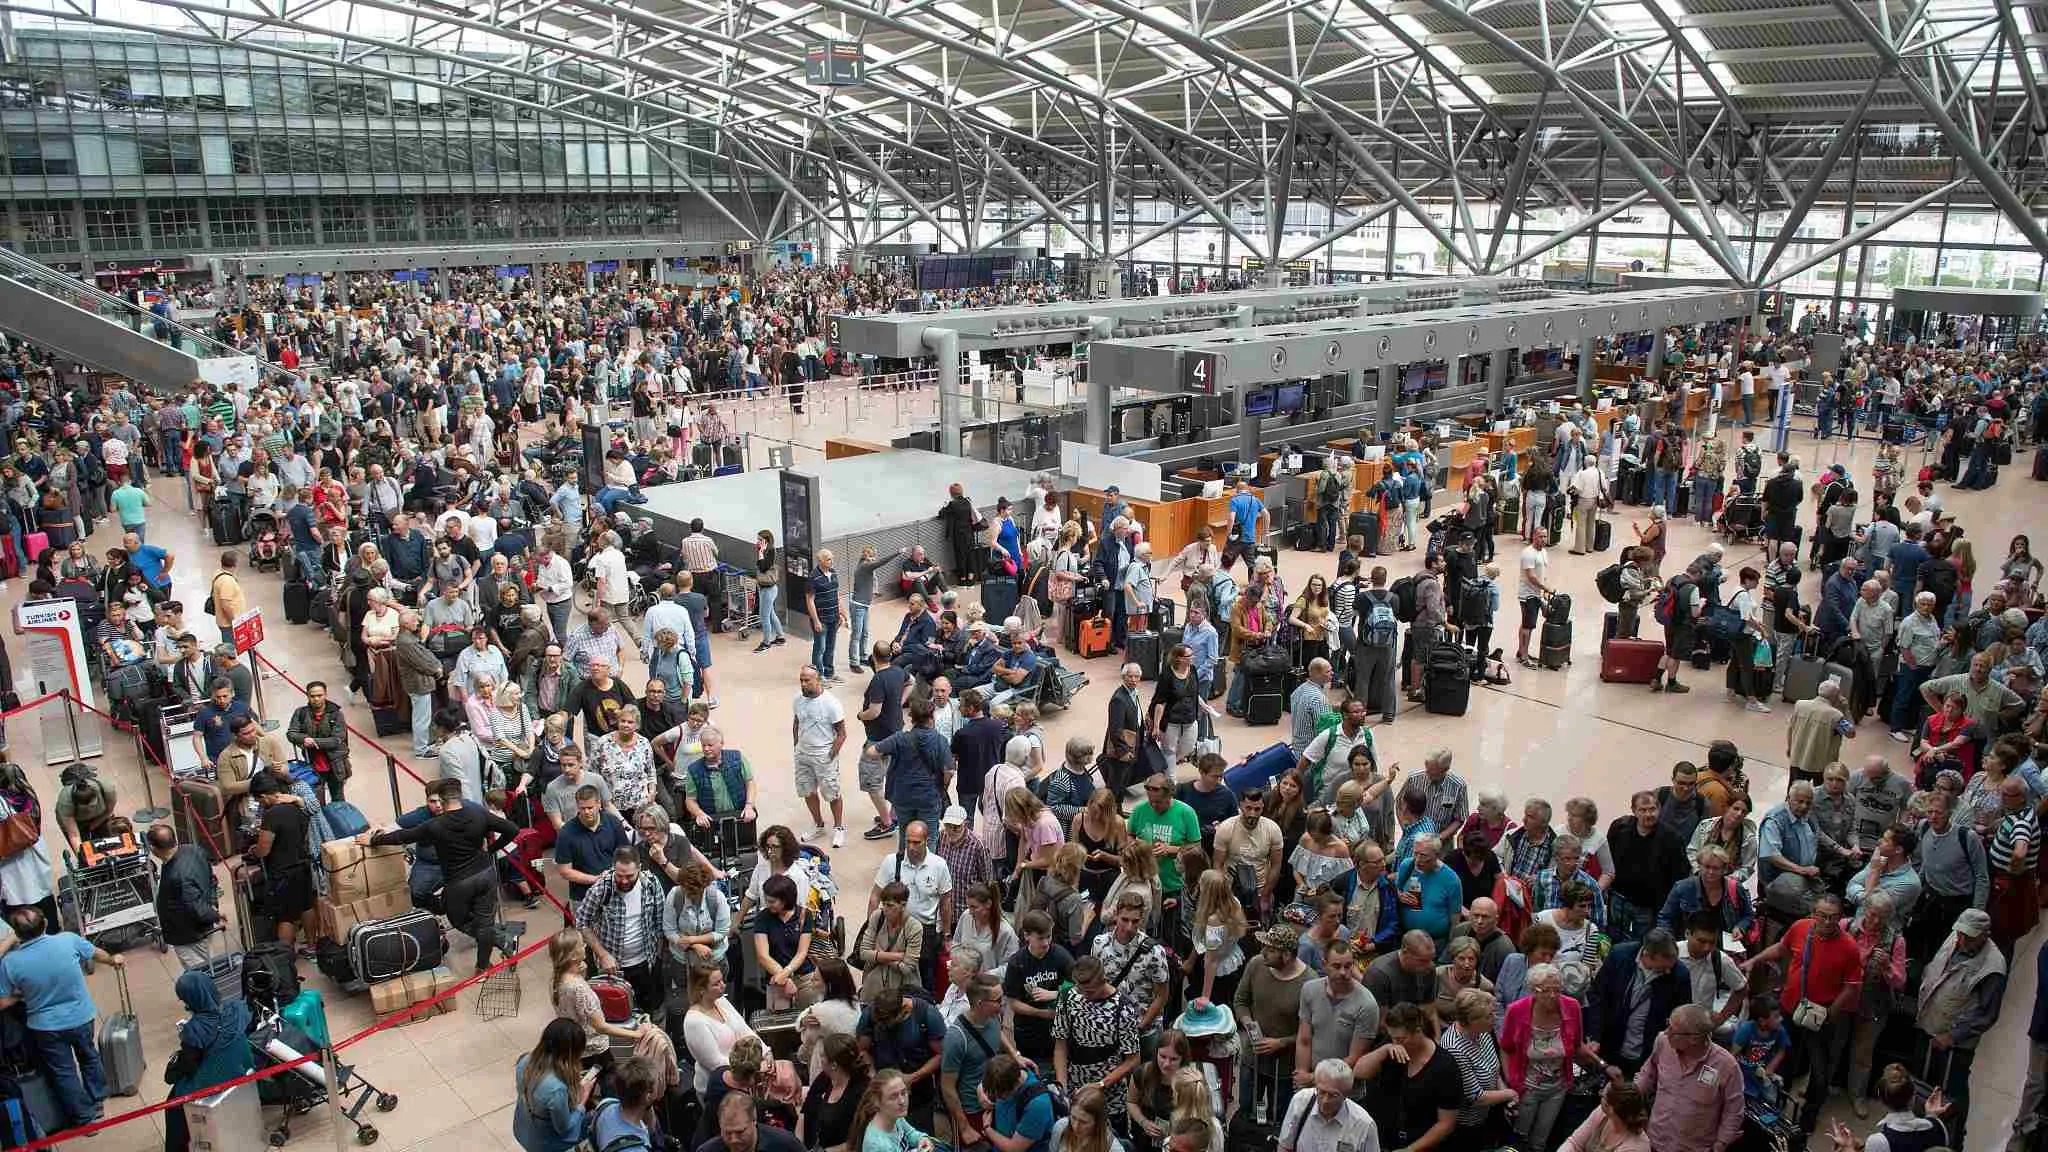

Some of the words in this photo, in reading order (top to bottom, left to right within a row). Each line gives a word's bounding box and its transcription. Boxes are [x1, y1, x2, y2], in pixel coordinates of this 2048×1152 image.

[1765, 294, 1776, 309] 4
[830, 321, 839, 339] 3
[1193, 359, 1207, 381] 4
[26, 612, 57, 620] TURKISH
